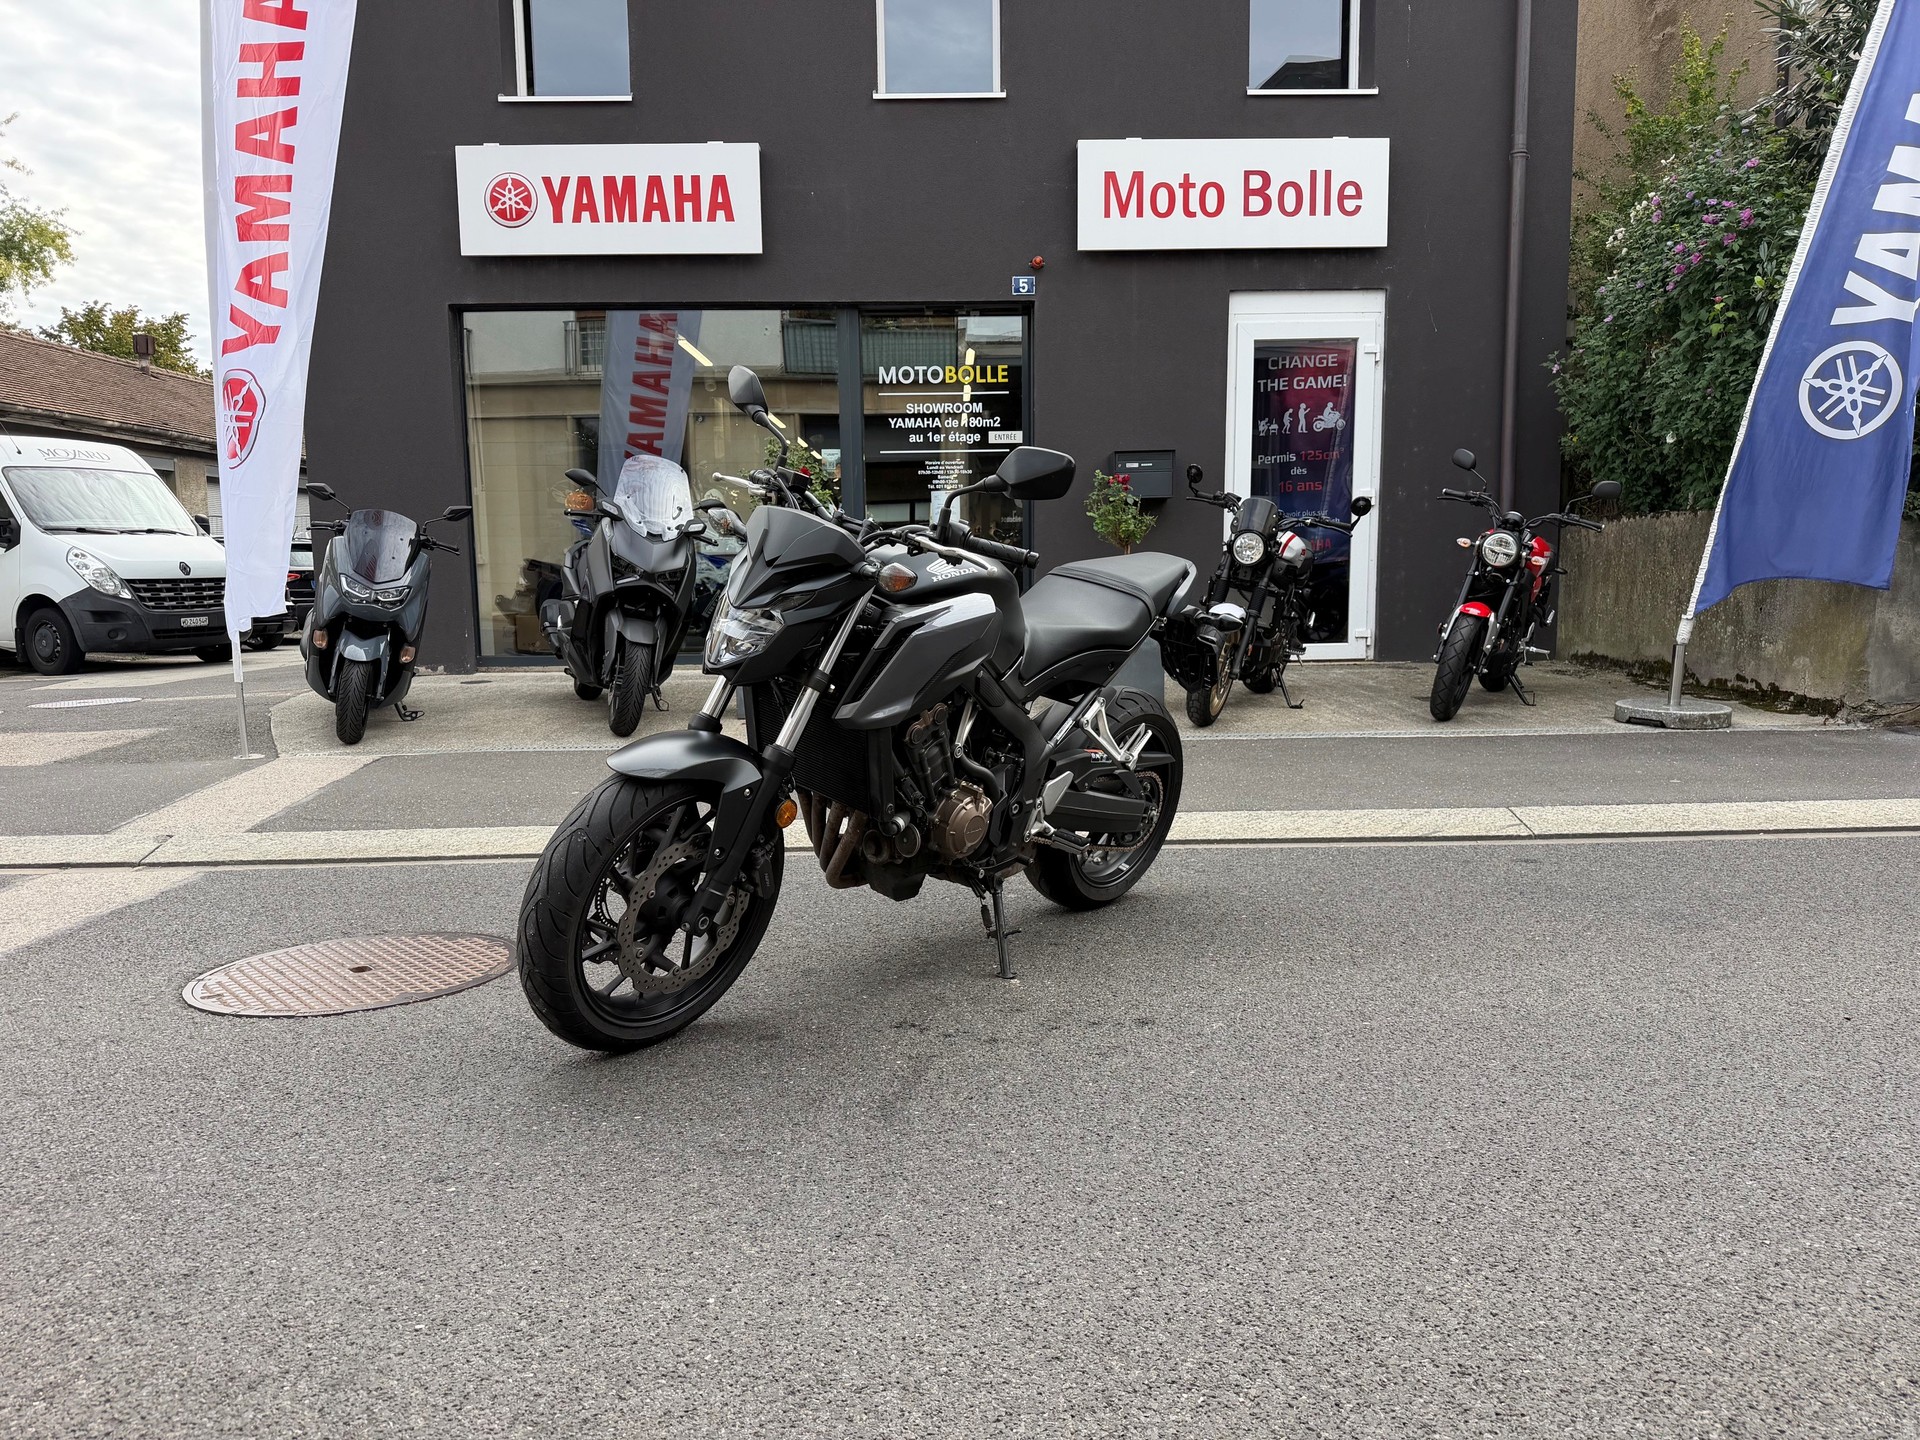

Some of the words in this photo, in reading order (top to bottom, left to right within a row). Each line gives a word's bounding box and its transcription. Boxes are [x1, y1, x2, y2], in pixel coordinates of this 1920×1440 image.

[541, 174, 736, 223] YAMAHA
[1103, 170, 1225, 219] Moto
[1243, 169, 1363, 217] Bolle
[1019, 279, 1029, 293] 5
[1268, 354, 1338, 370] CHANGE
[878, 364, 1009, 385] MOTOBOLLE
[624, 313, 678, 459] AMAHA
[1257, 377, 1289, 393] THE
[1293, 374, 1347, 390] GAME!
[906, 402, 983, 414] SHOWROOM
[888, 417, 941, 429] YAMAHA
[944, 417, 959, 428] de
[909, 433, 924, 443] au
[927, 432, 946, 443] 1er
[948, 431, 981, 445] étage
[994, 432, 1017, 441] ENTRÉE
[1258, 451, 1297, 465] Permis
[1290, 466, 1307, 476] dès
[1279, 480, 1293, 493] 16
[1297, 480, 1323, 492] ans
[932, 567, 978, 582] HONDA
